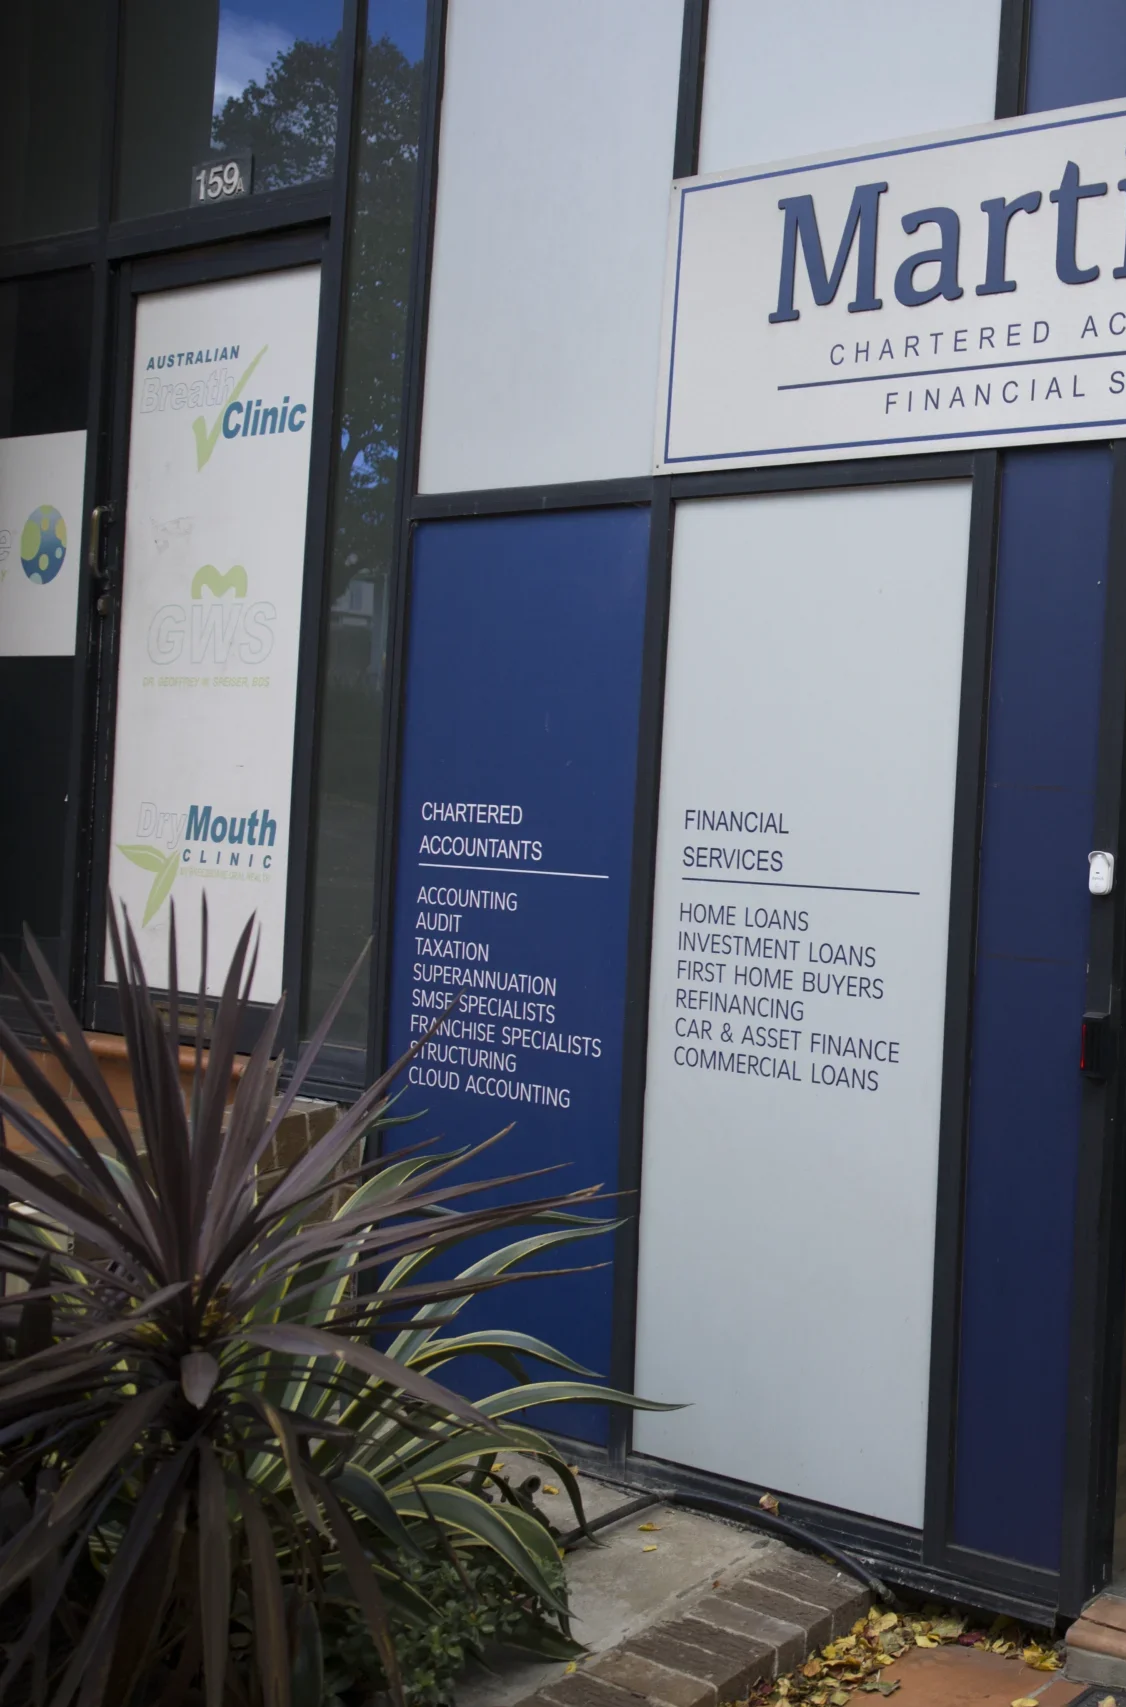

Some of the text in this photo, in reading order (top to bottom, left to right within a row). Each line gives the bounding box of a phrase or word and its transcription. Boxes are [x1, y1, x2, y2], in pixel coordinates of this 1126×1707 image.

[146, 345, 240, 371] AUSTRALIAN
[830, 320, 1050, 366] CHARTERED
[140, 367, 307, 439] Breath Clinic
[885, 374, 1085, 415] FINANCIAL
[146, 601, 277, 666] GWS
[421, 801, 523, 825] CHARTERED
[684, 809, 790, 834] FINANCIAL
[182, 848, 272, 869] CLINIC
[418, 835, 543, 861] ACCOUNTANTS
[682, 846, 784, 872] SERVICES
[416, 886, 518, 912] ACCOUNTING
[415, 911, 463, 933] AUDIT
[679, 902, 809, 932] HOME LOANS
[414, 937, 490, 962] TAXATION
[678, 931, 876, 968] INVESTMENT LOANS
[412, 963, 557, 997] SUPERANNUATION
[677, 960, 884, 1000] FIRST HOME BUYERS
[412, 988, 556, 1024] SMSF SPECIALISTS
[676, 988, 804, 1022] REFINANCING
[410, 1014, 602, 1058] FRANCHISE SPECIALISTS
[675, 1017, 900, 1063] CAR & ASSET FINANCE
[673, 1046, 879, 1092] COMMERCIAL LOANS
[408, 1066, 571, 1108] CLOUD ACCOUNTING
